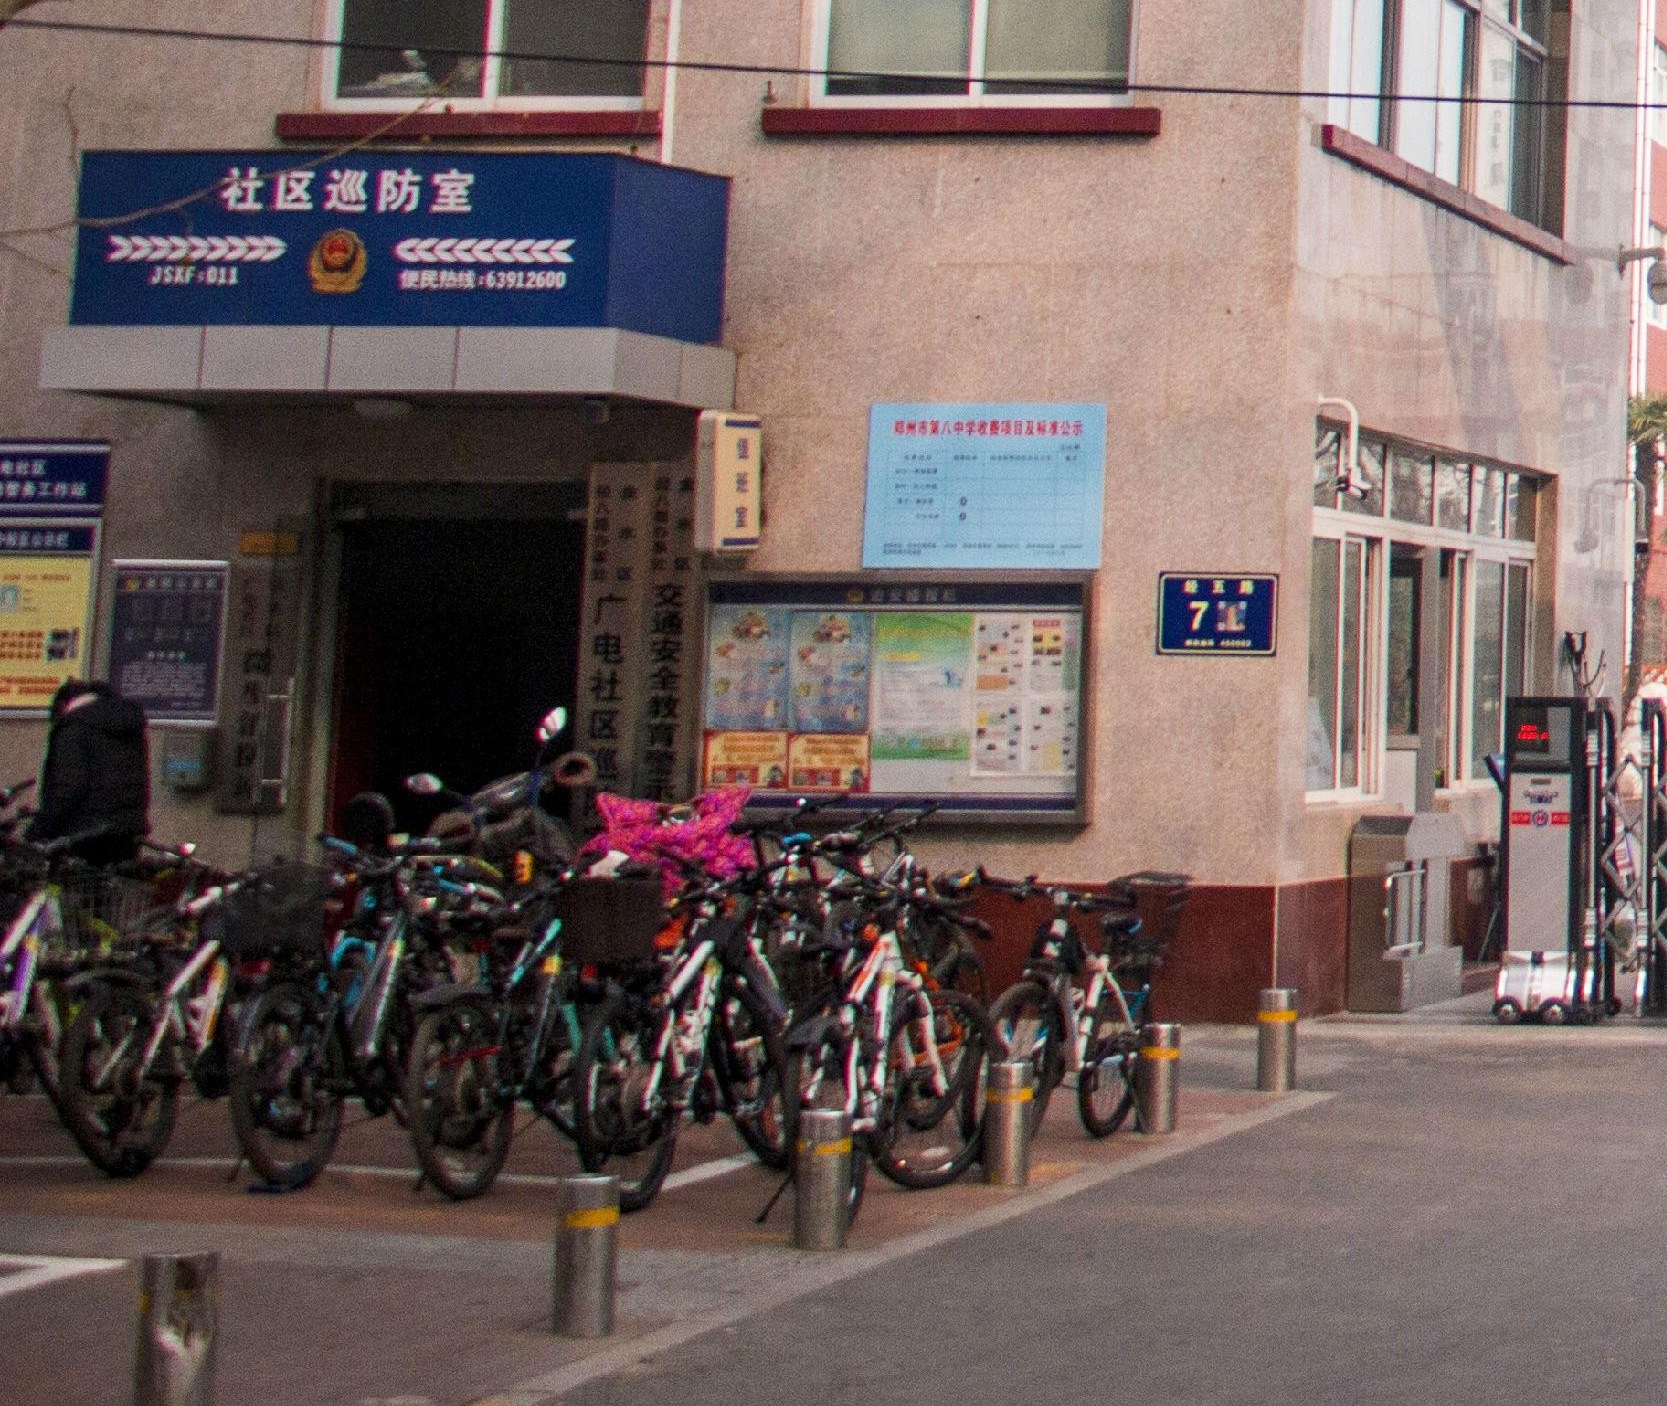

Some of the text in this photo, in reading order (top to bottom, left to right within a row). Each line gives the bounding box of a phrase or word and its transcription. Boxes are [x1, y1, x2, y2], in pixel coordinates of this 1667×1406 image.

[222, 168, 475, 213] 社区巡防室
[1190, 601, 1210, 632] 7
